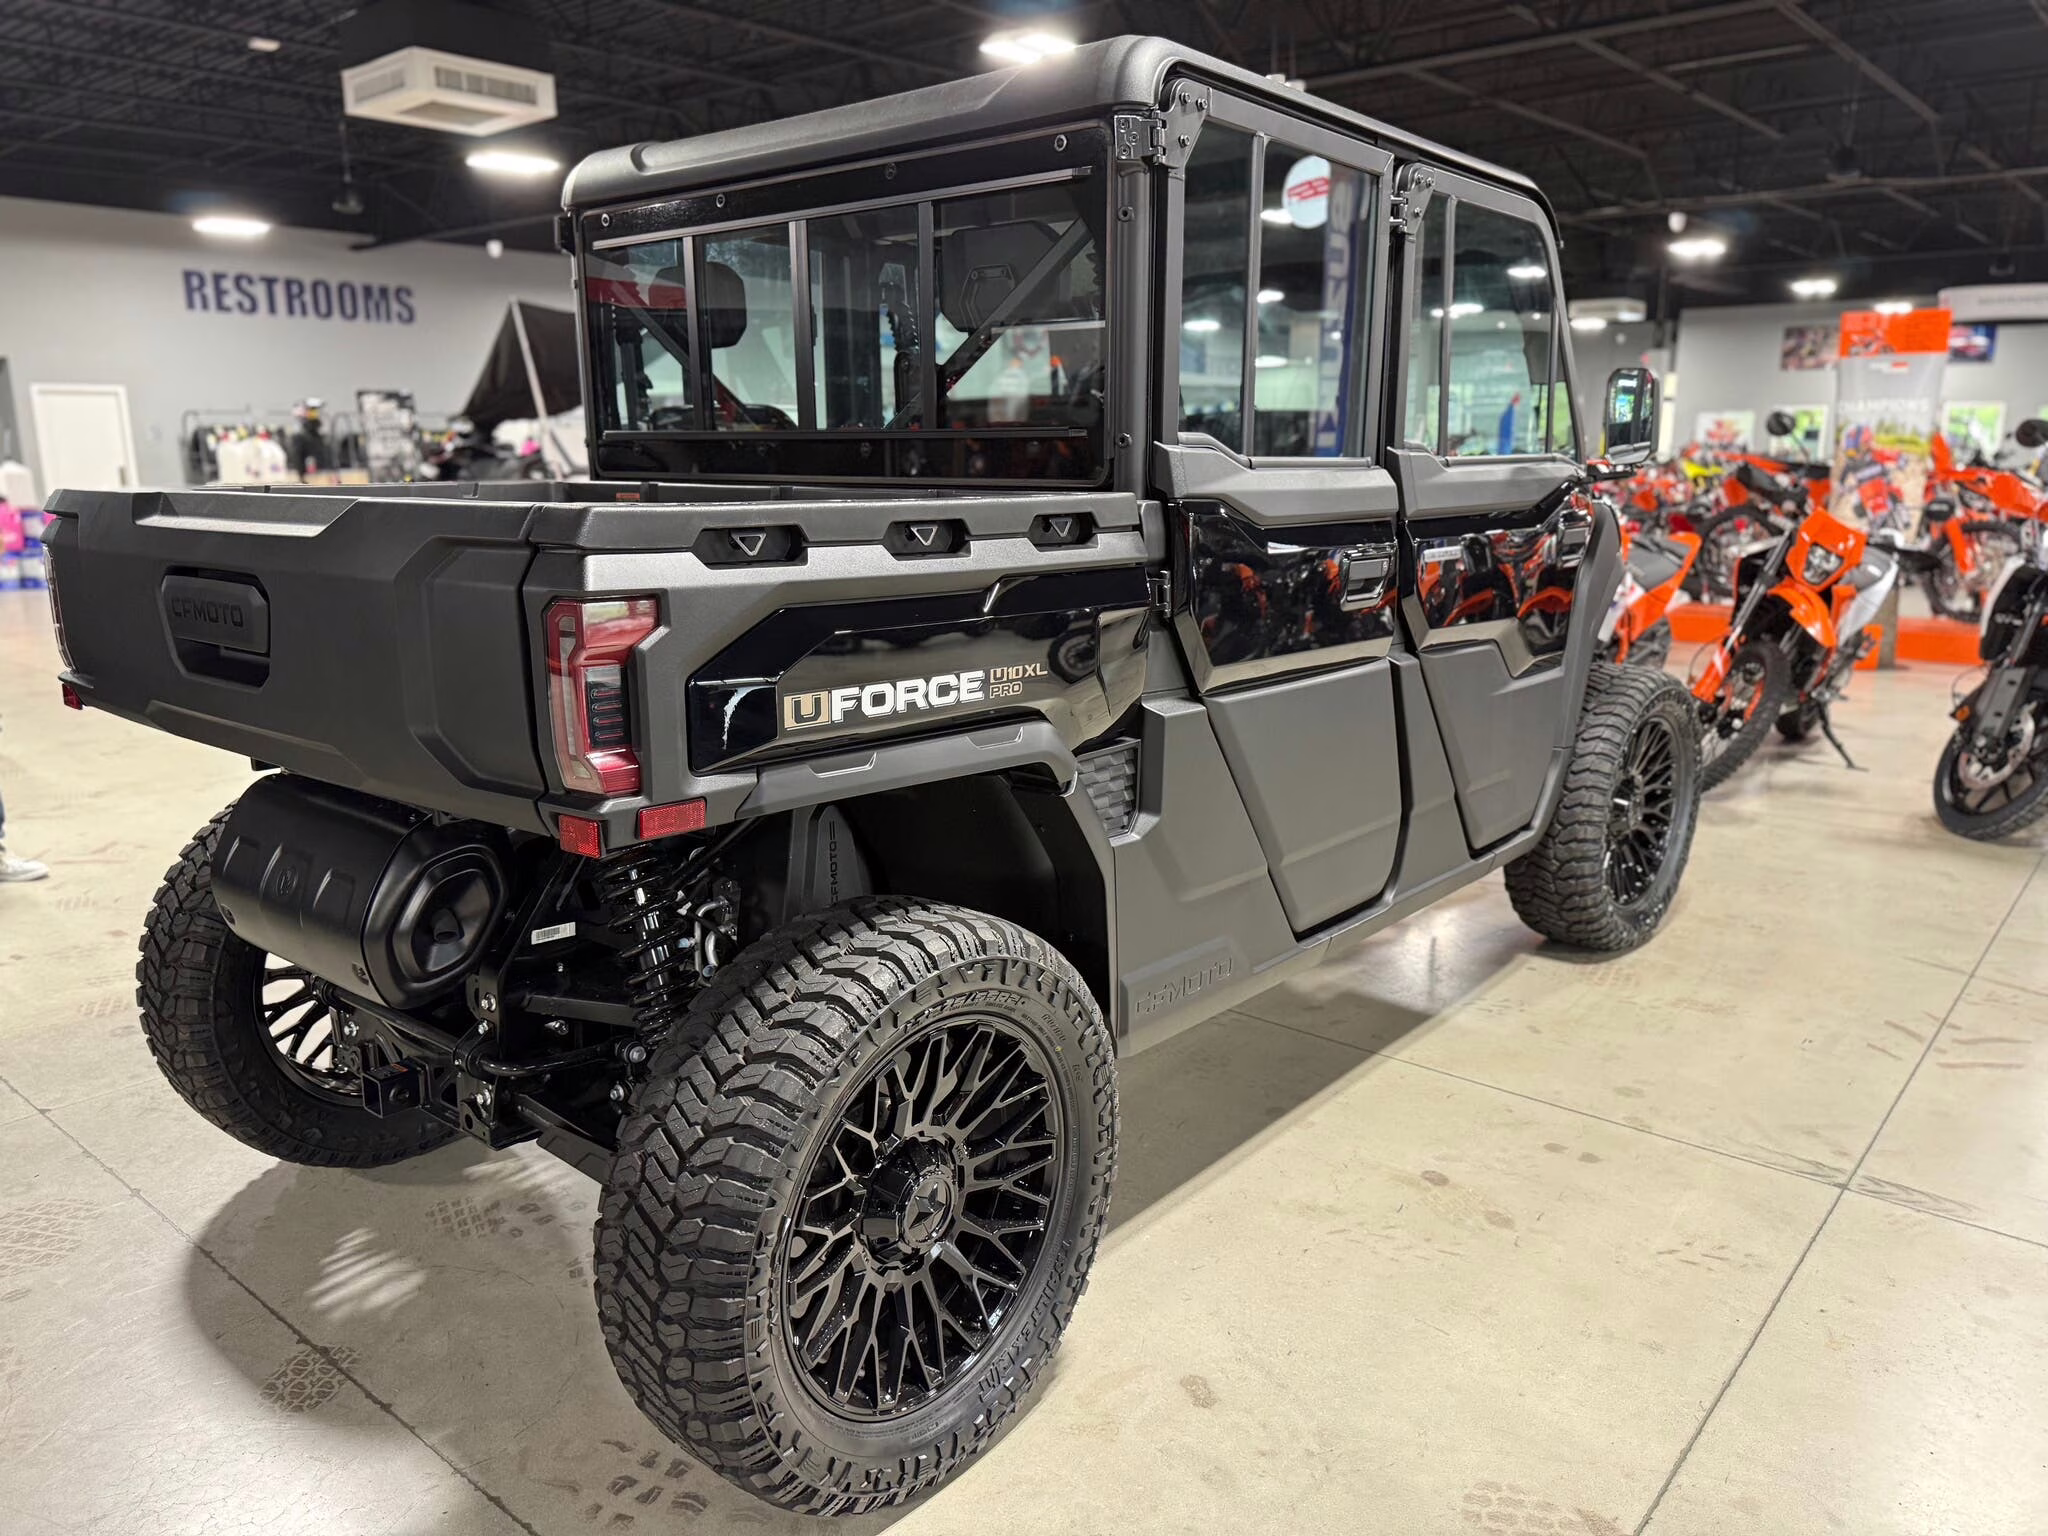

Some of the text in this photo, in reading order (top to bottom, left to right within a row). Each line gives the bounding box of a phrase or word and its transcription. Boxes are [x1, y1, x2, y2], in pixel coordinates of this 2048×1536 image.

[182, 269, 416, 324] RESTROOMS
[171, 598, 244, 628] CFMOTO
[990, 681, 1023, 698] PRO
[1136, 957, 1232, 1014] CFMOTO
